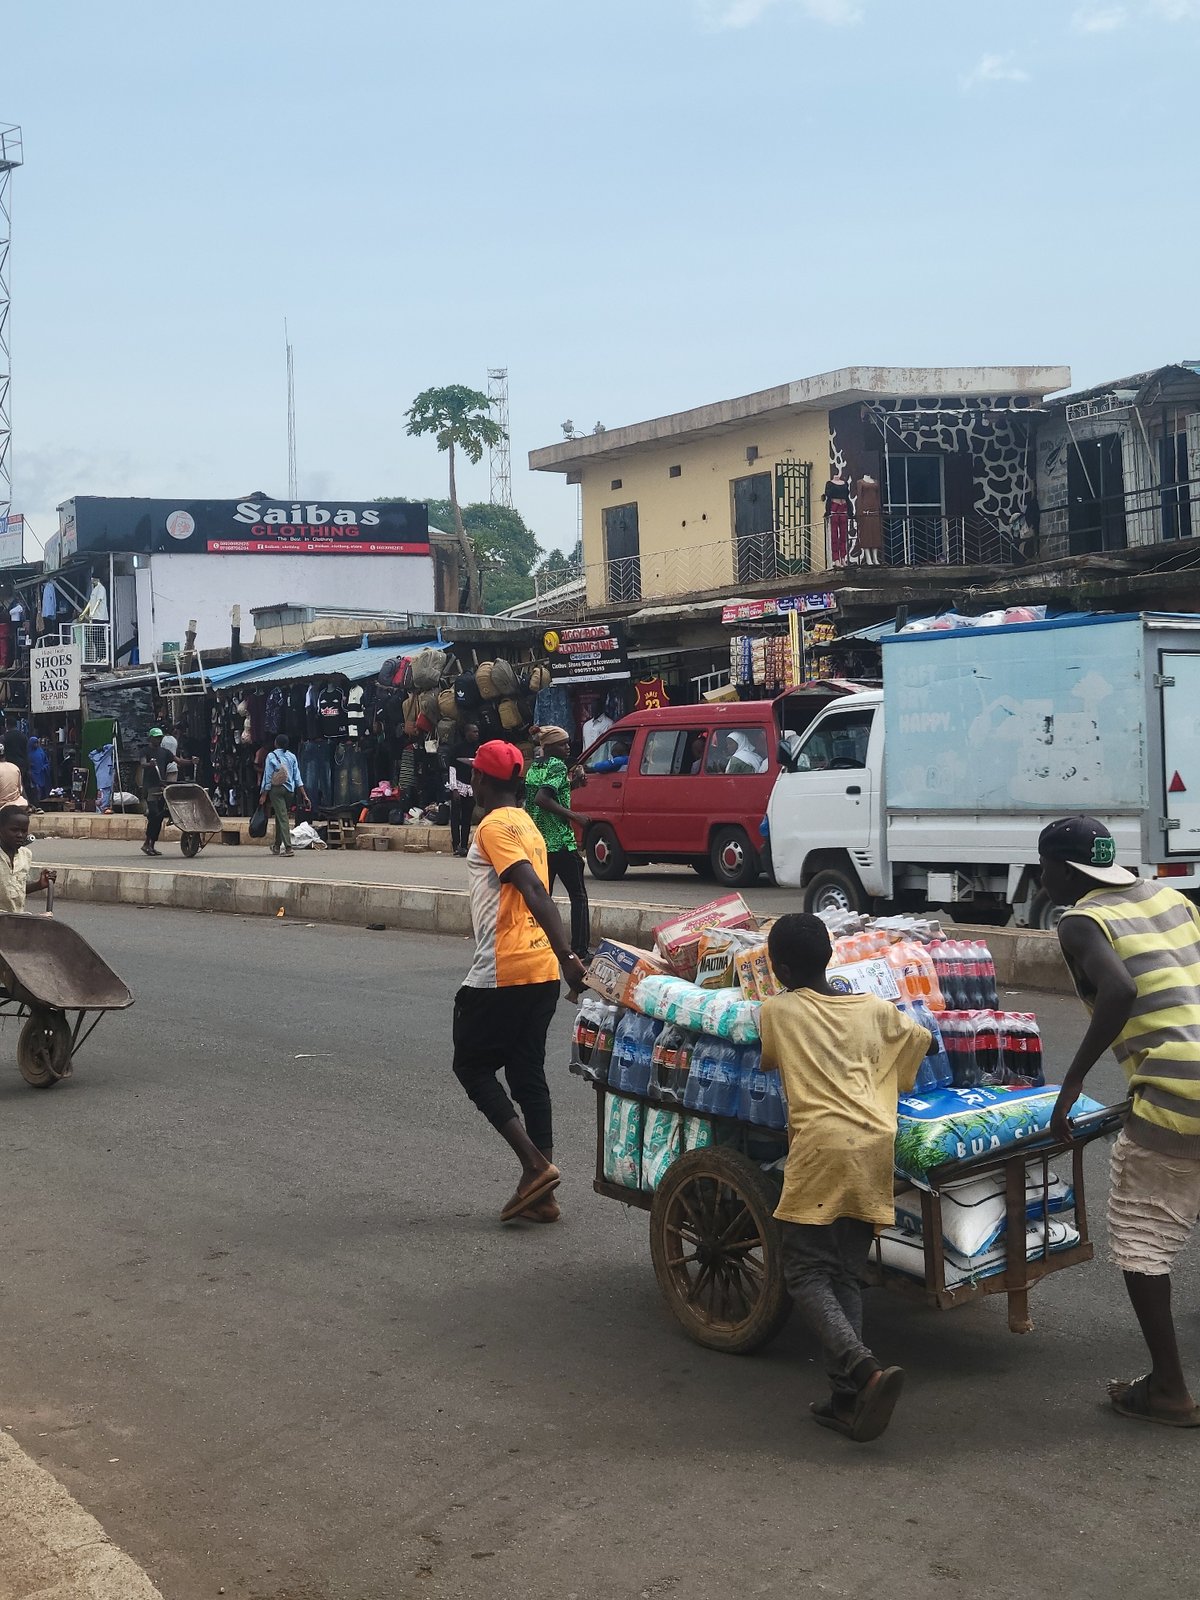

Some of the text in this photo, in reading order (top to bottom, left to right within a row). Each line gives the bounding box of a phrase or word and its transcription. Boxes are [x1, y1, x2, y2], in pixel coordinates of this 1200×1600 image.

[232, 502, 380, 525] Saibas
[251, 525, 359, 537] CLOTHING
[557, 640, 596, 654] CLOTHING
[35, 654, 72, 669] SHOES
[42, 668, 67, 679] AND
[40, 679, 69, 692] BAGS
[41, 692, 68, 700] REPAIRS
[645, 699, 660, 710] 23
[956, 1135, 1000, 1158] BUA
